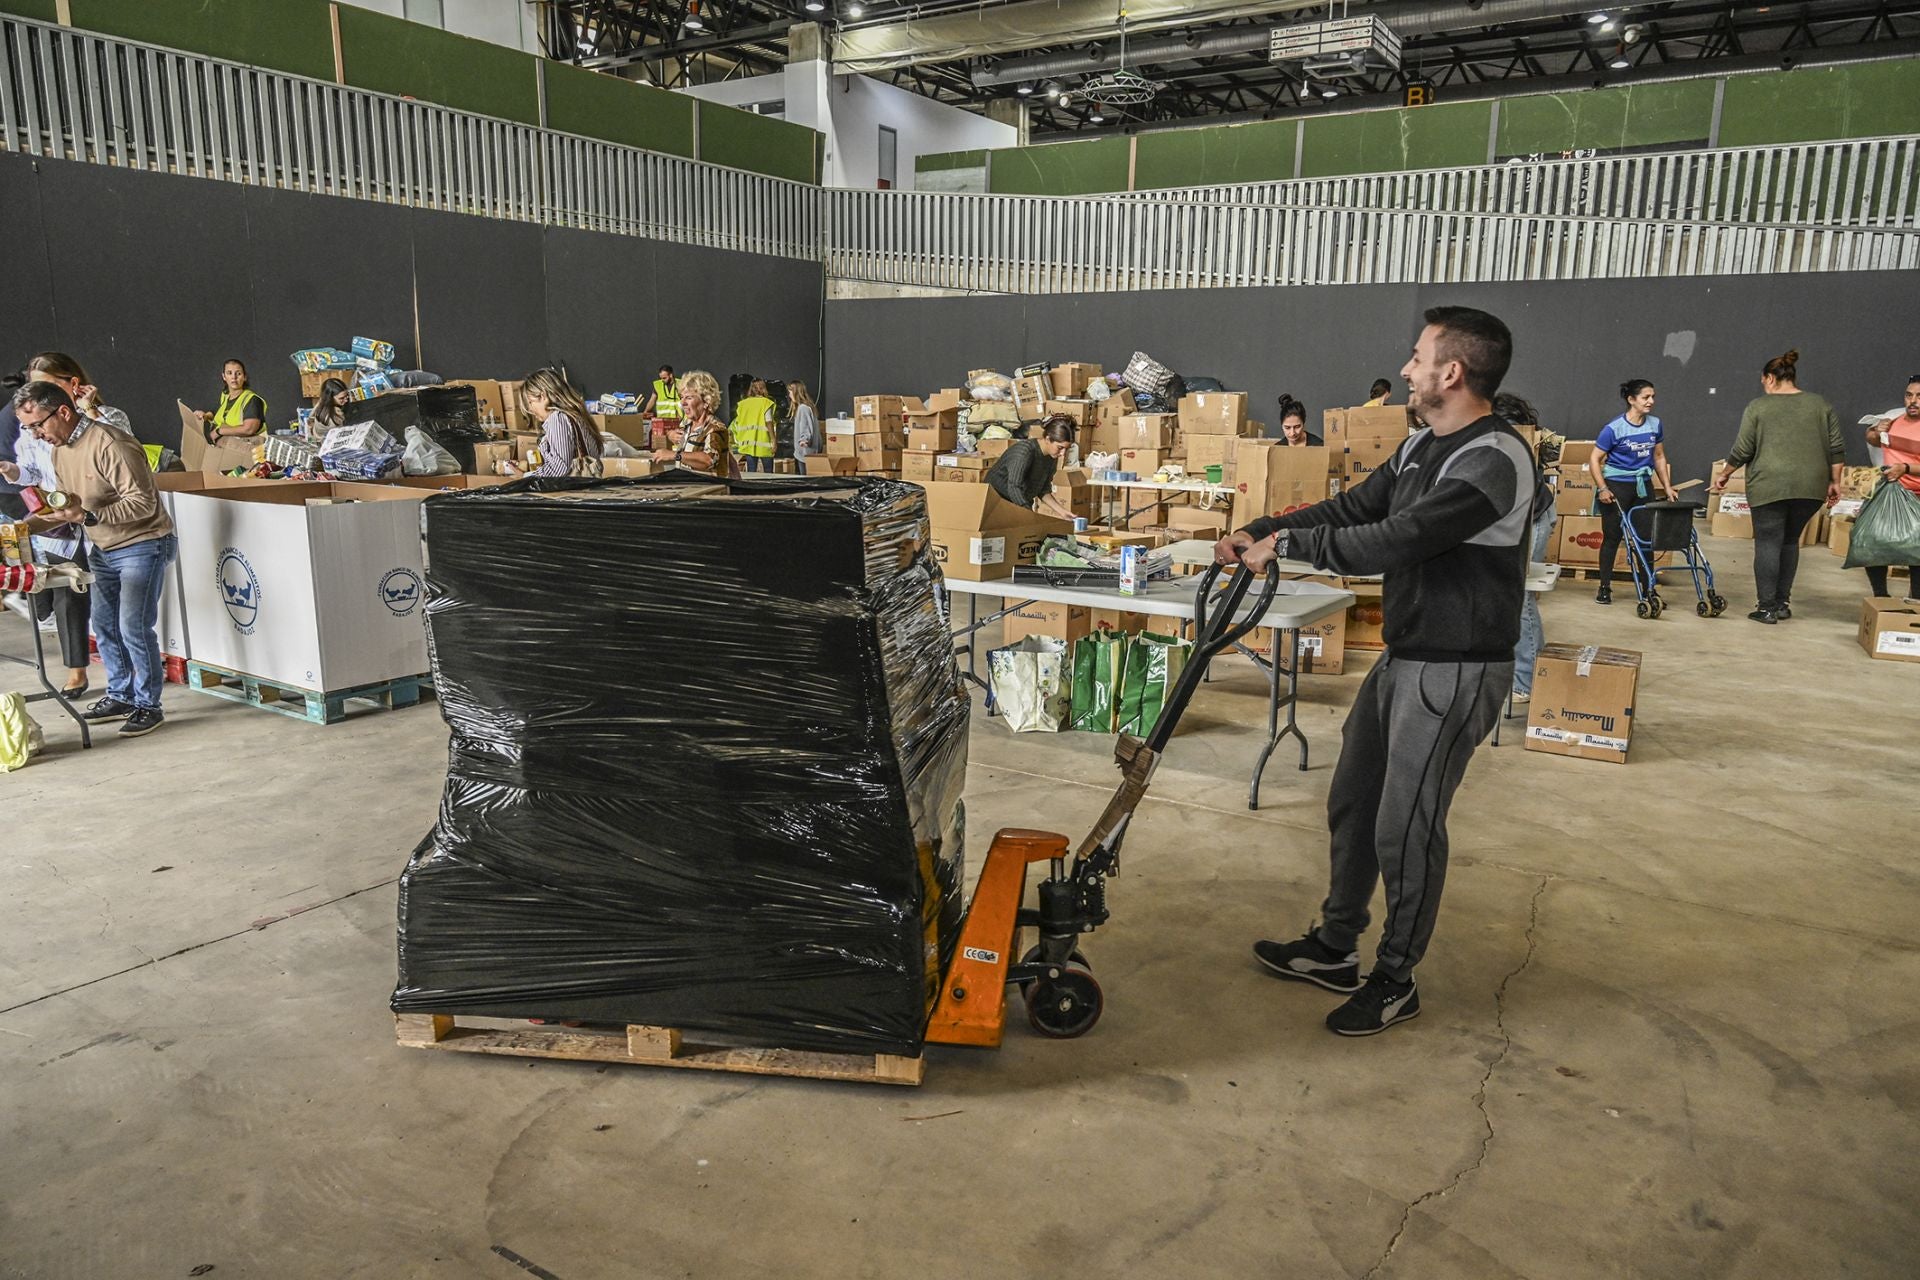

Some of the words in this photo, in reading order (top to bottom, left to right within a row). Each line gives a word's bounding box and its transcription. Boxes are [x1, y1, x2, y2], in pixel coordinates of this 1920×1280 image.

[1407, 87, 1424, 107] B
[1561, 707, 1615, 732] Massilly
[1585, 734, 1614, 748] Massilly
[966, 948, 978, 959] CE
